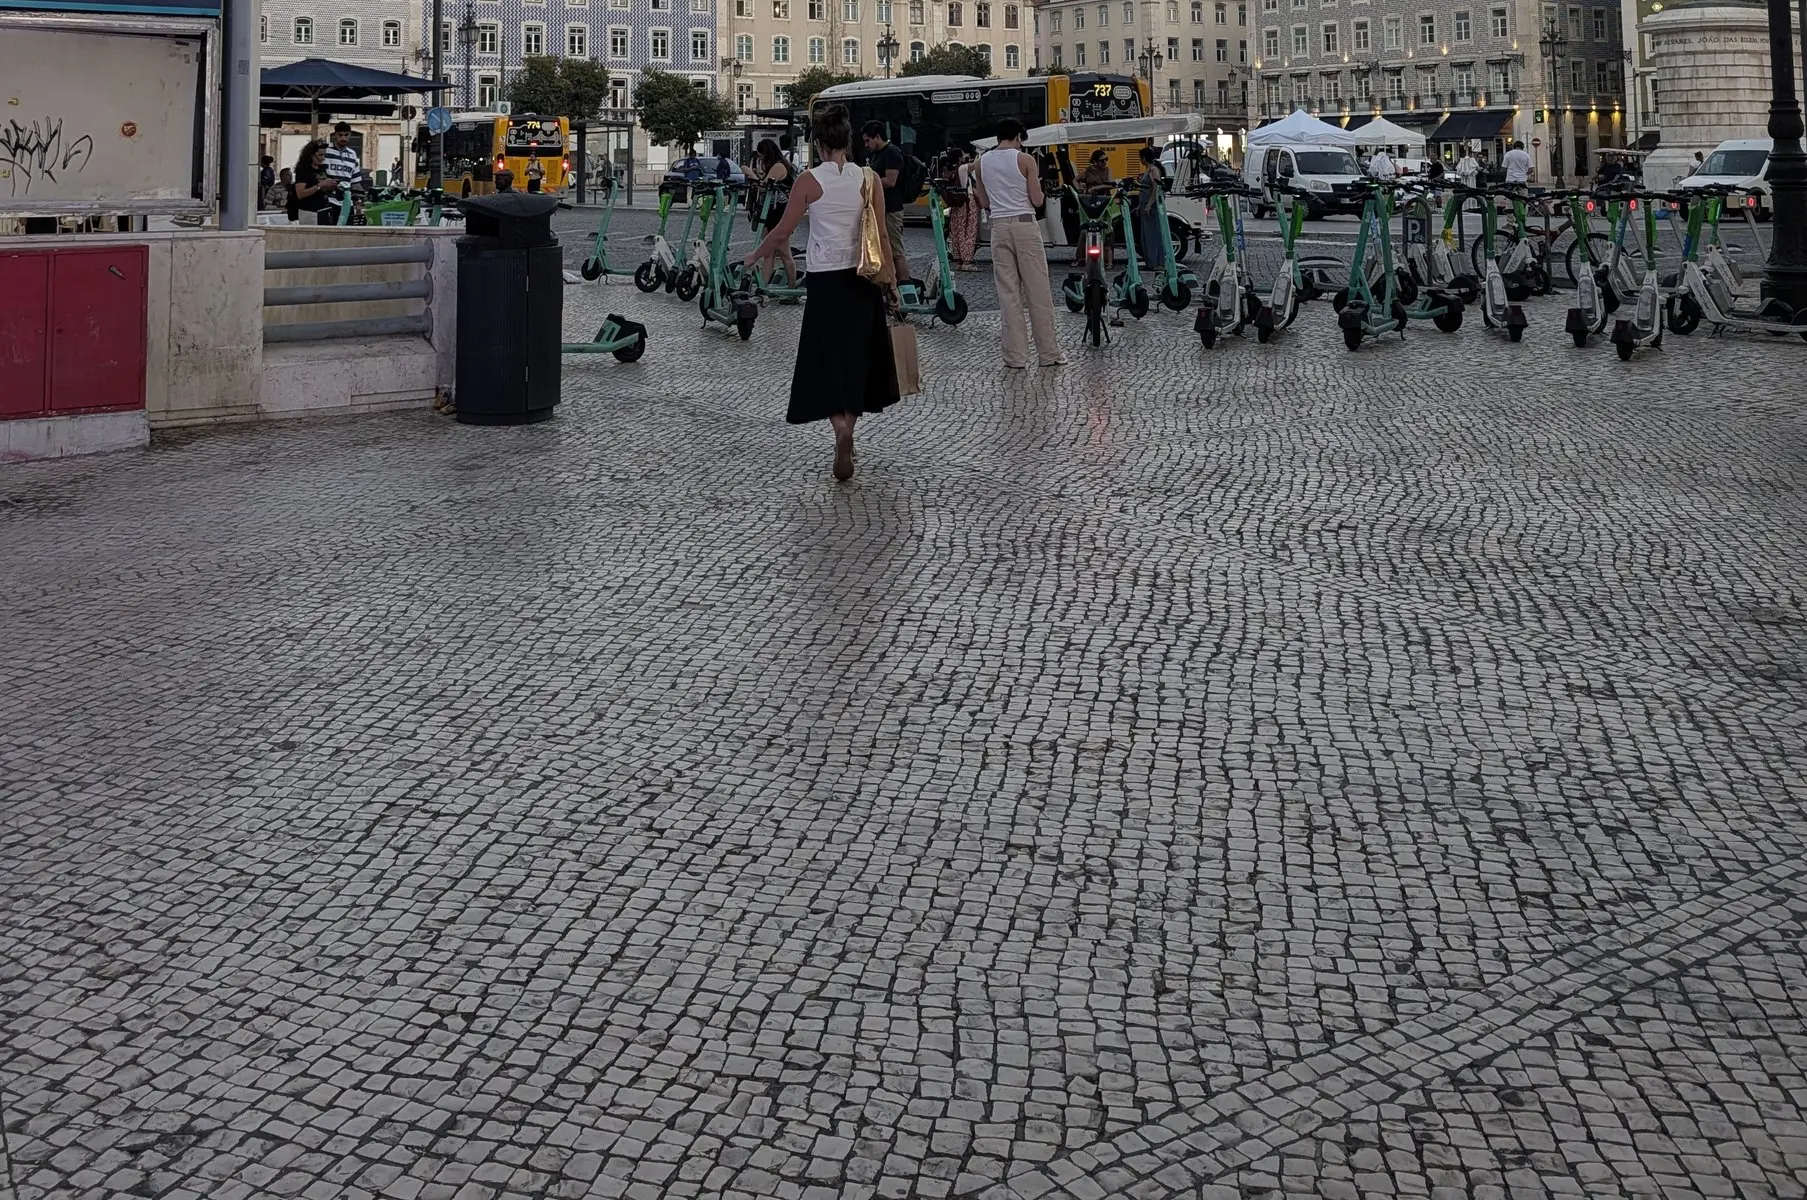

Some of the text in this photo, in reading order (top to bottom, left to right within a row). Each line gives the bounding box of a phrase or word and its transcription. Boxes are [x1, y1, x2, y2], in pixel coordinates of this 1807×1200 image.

[1094, 84, 1112, 96] 737
[526, 121, 540, 129] 774
[1407, 219, 1421, 241] P
